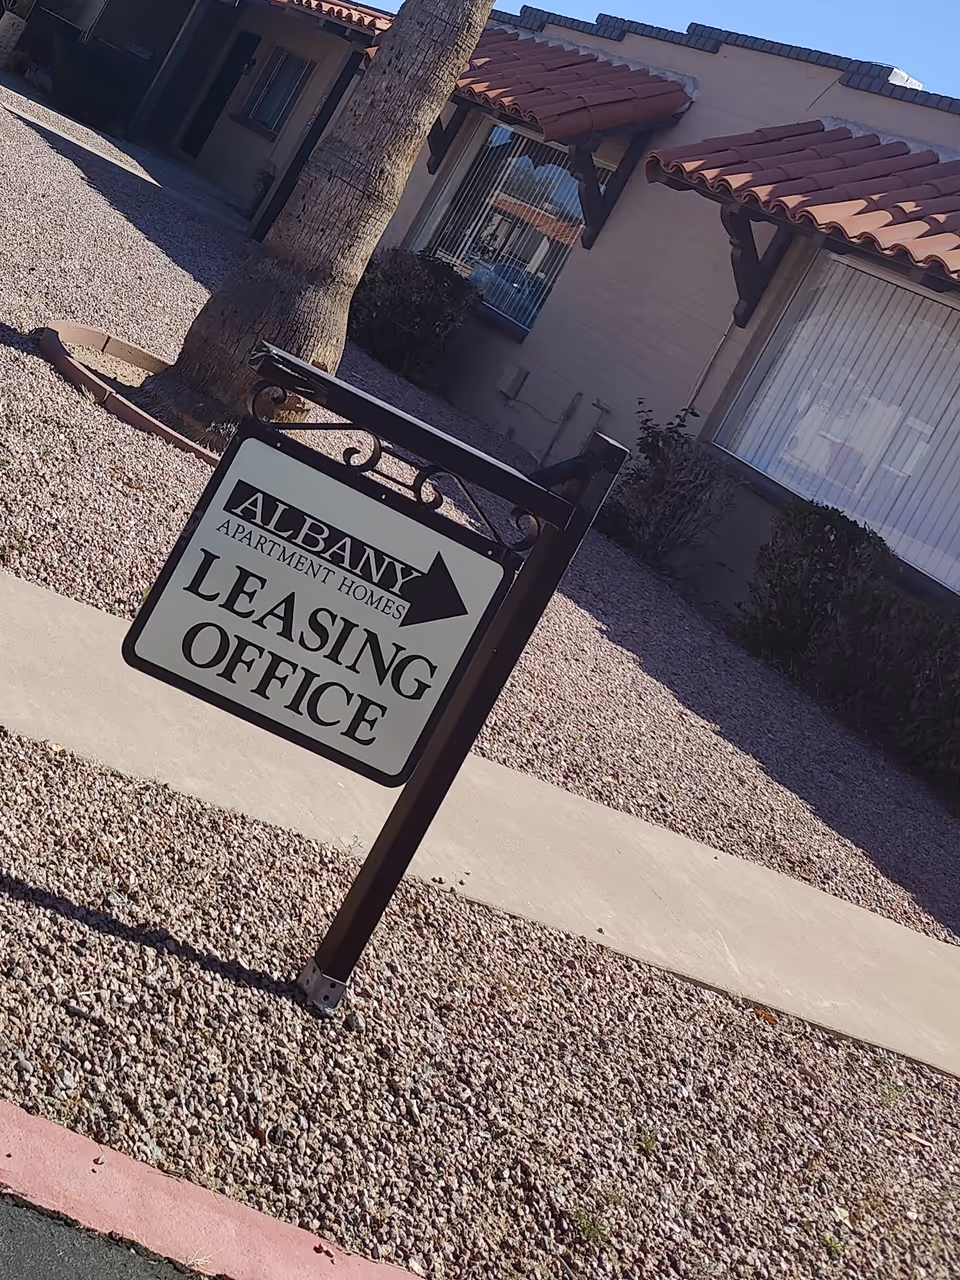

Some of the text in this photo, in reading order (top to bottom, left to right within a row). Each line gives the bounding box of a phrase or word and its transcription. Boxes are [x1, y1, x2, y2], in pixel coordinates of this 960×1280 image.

[216, 519, 407, 620] APARTMENT HOMES
[231, 491, 423, 596] ALBANY
[182, 548, 438, 701] LEASING
[181, 621, 388, 746] OFFICE
